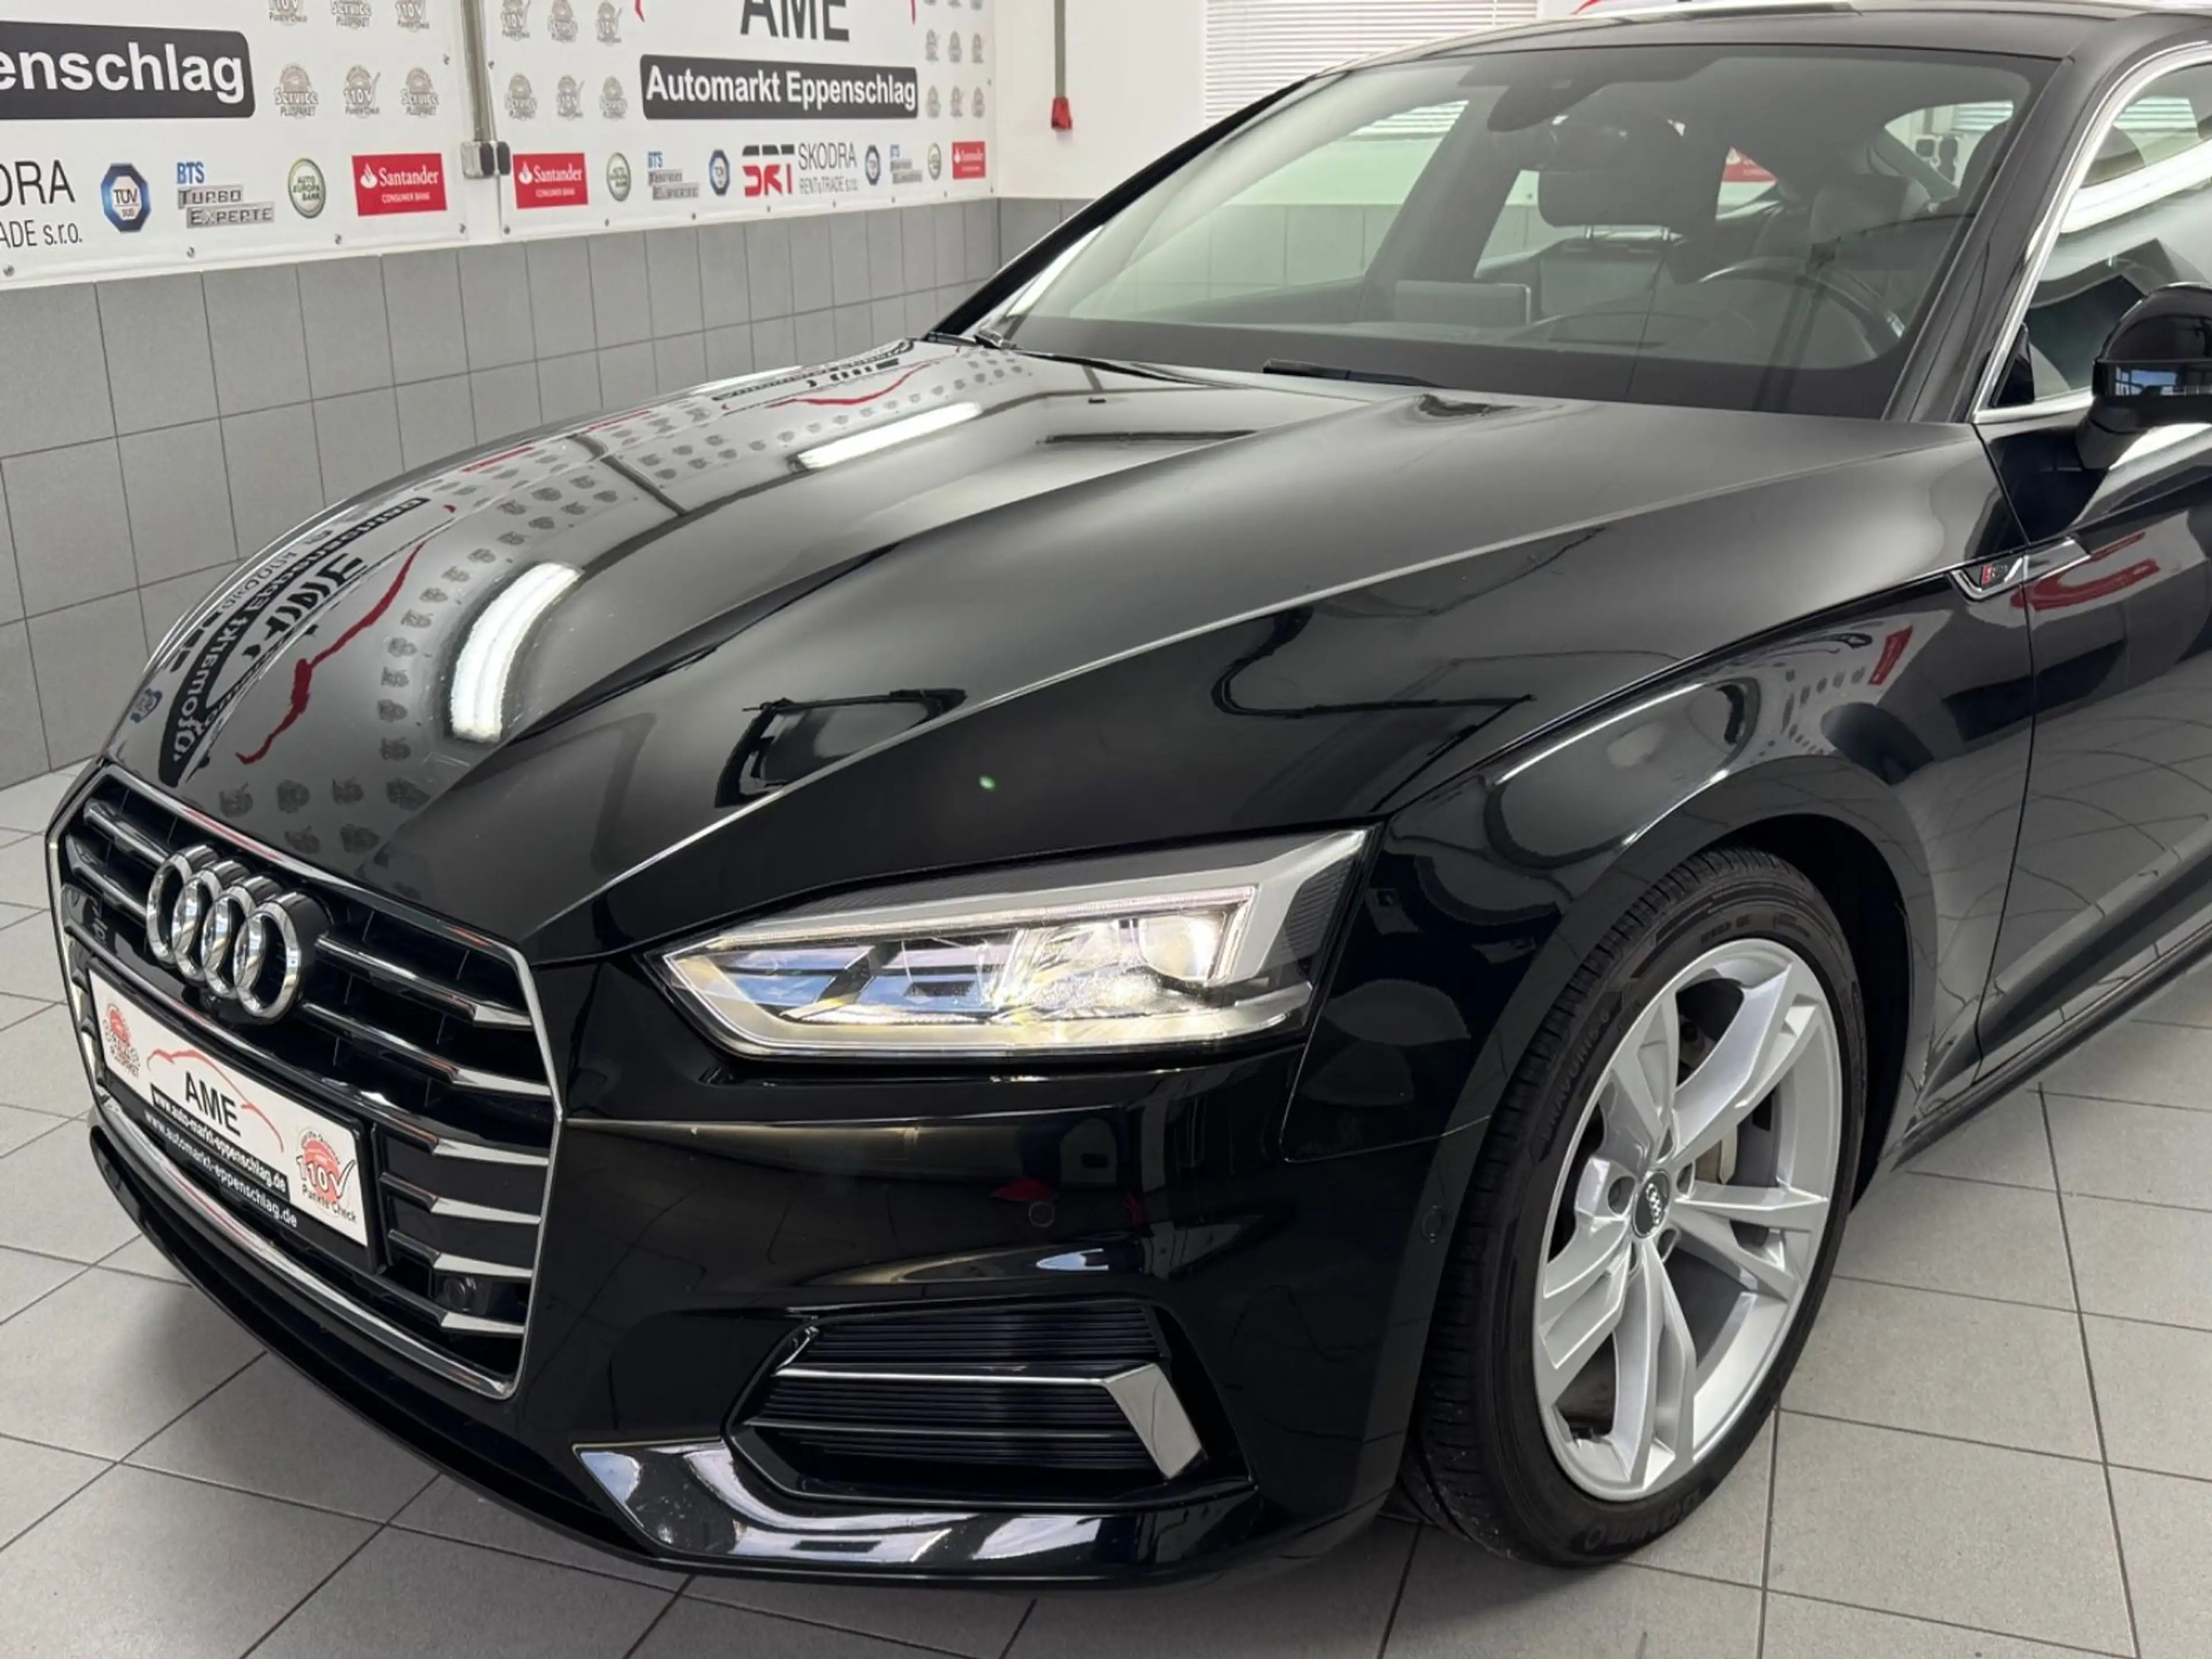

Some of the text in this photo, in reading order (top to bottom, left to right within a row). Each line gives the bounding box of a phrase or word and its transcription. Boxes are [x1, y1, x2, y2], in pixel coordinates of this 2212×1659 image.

[646, 65, 915, 111] Automarkt Eppenschlag
[798, 142, 857, 171] SKODRA
[177, 161, 204, 184] BTS
[378, 164, 438, 187] Santander
[533, 163, 582, 183] Santander
[43, 222, 82, 245] s.r.o.
[185, 1070, 241, 1138] AME
